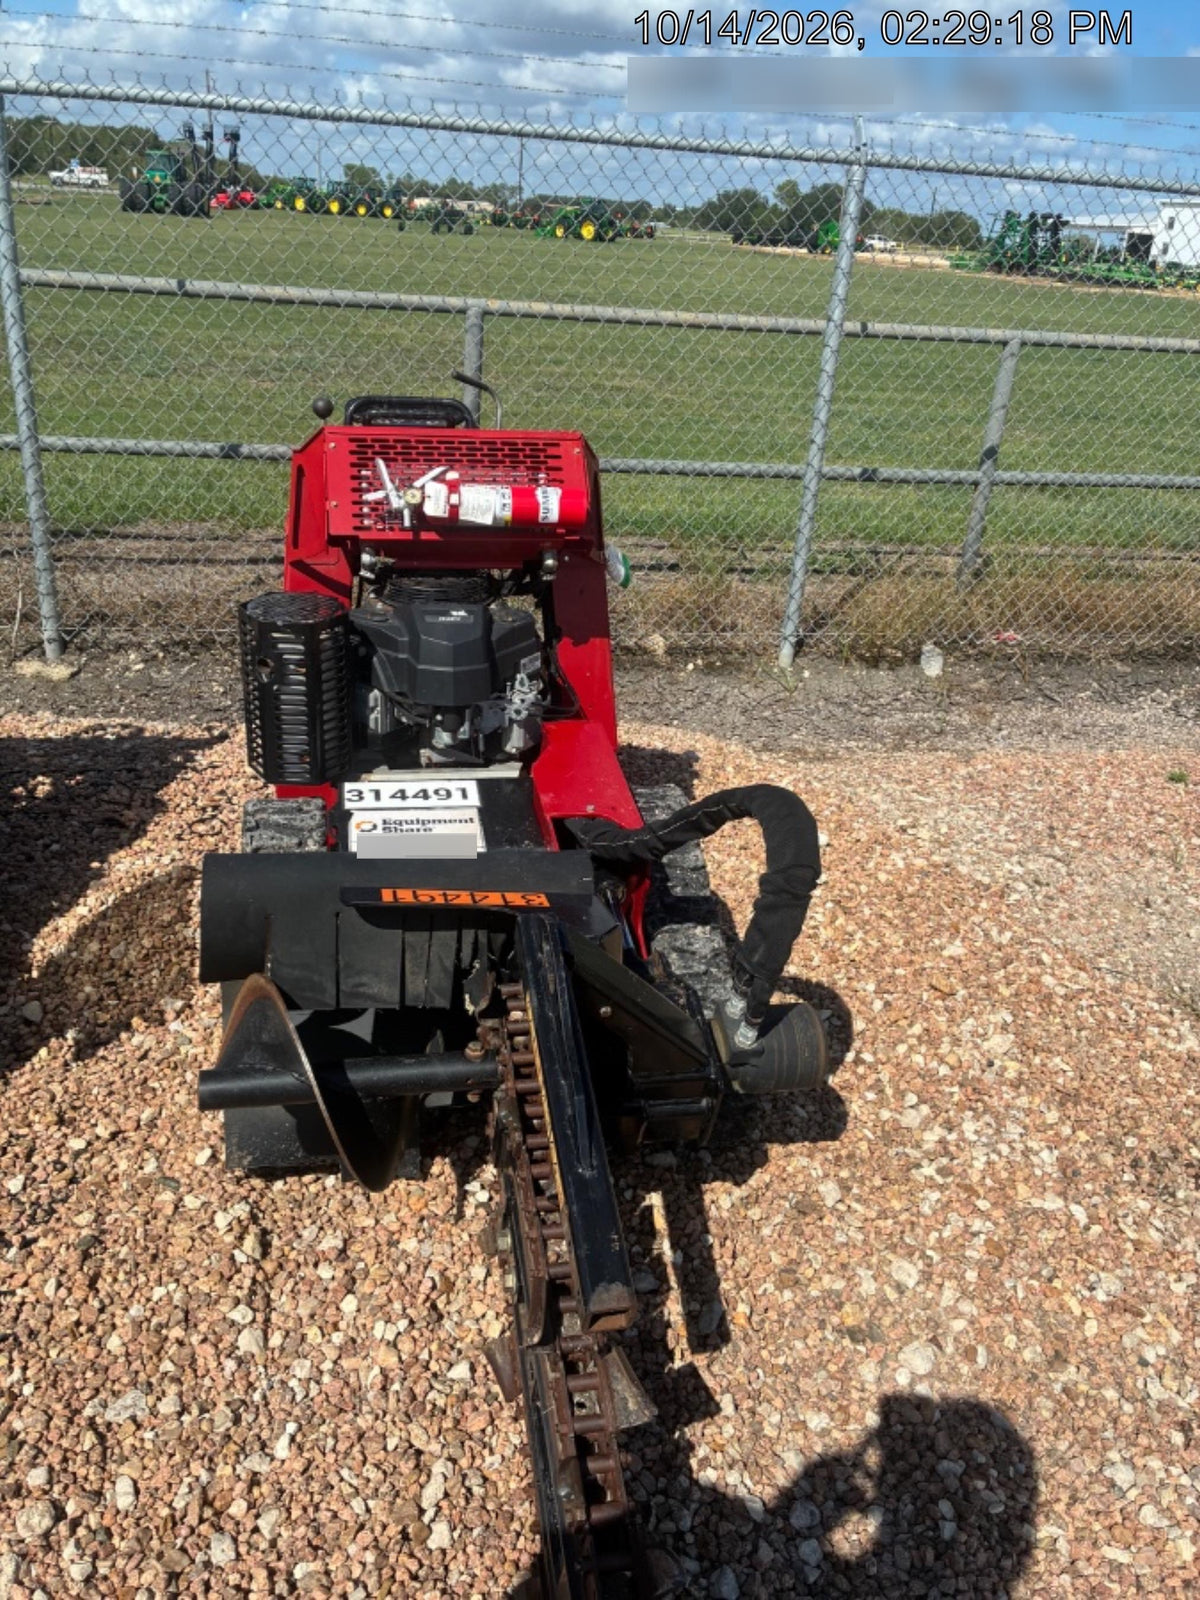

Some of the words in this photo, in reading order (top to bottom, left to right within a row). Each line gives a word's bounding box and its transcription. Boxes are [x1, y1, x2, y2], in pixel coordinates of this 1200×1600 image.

[346, 787, 468, 803] 314491
[382, 817, 476, 827] Equipment
[391, 890, 544, 905] 314491
